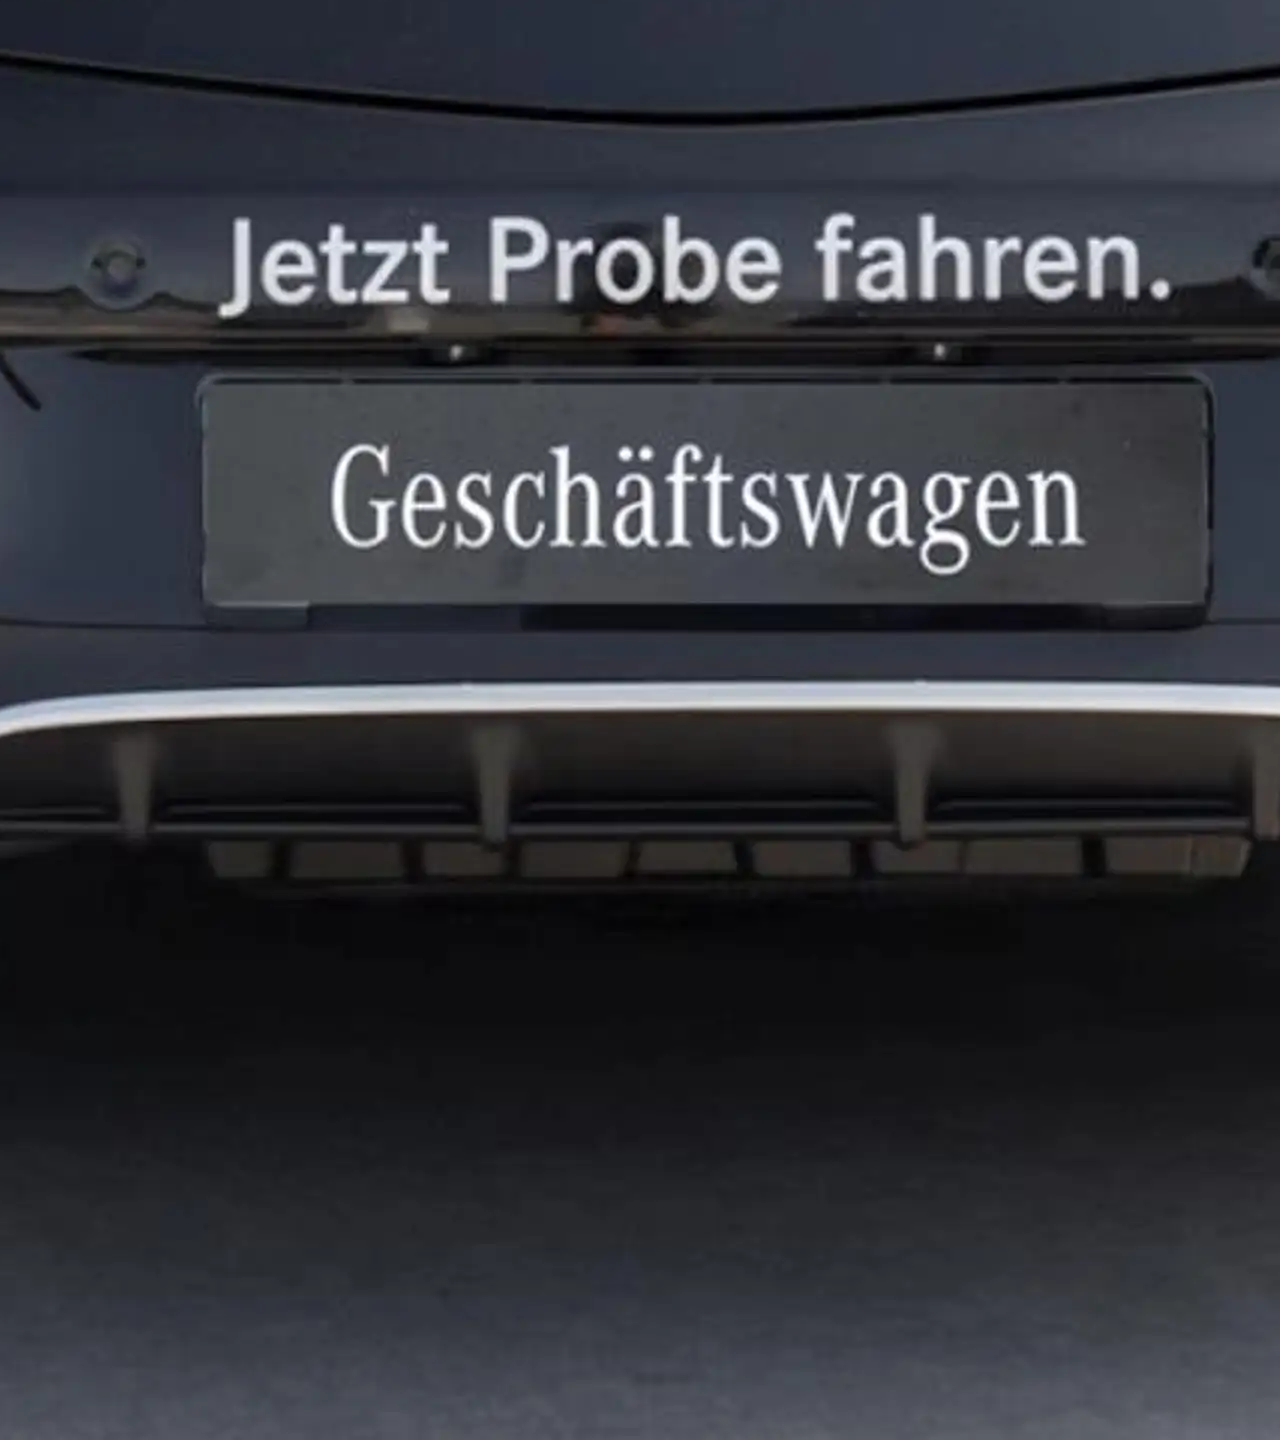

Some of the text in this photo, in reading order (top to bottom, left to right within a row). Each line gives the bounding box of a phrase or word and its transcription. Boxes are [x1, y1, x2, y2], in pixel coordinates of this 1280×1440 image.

[217, 213, 1174, 319] Jetzt Probe fahren.
[328, 442, 1087, 577] Geschäftswagen
